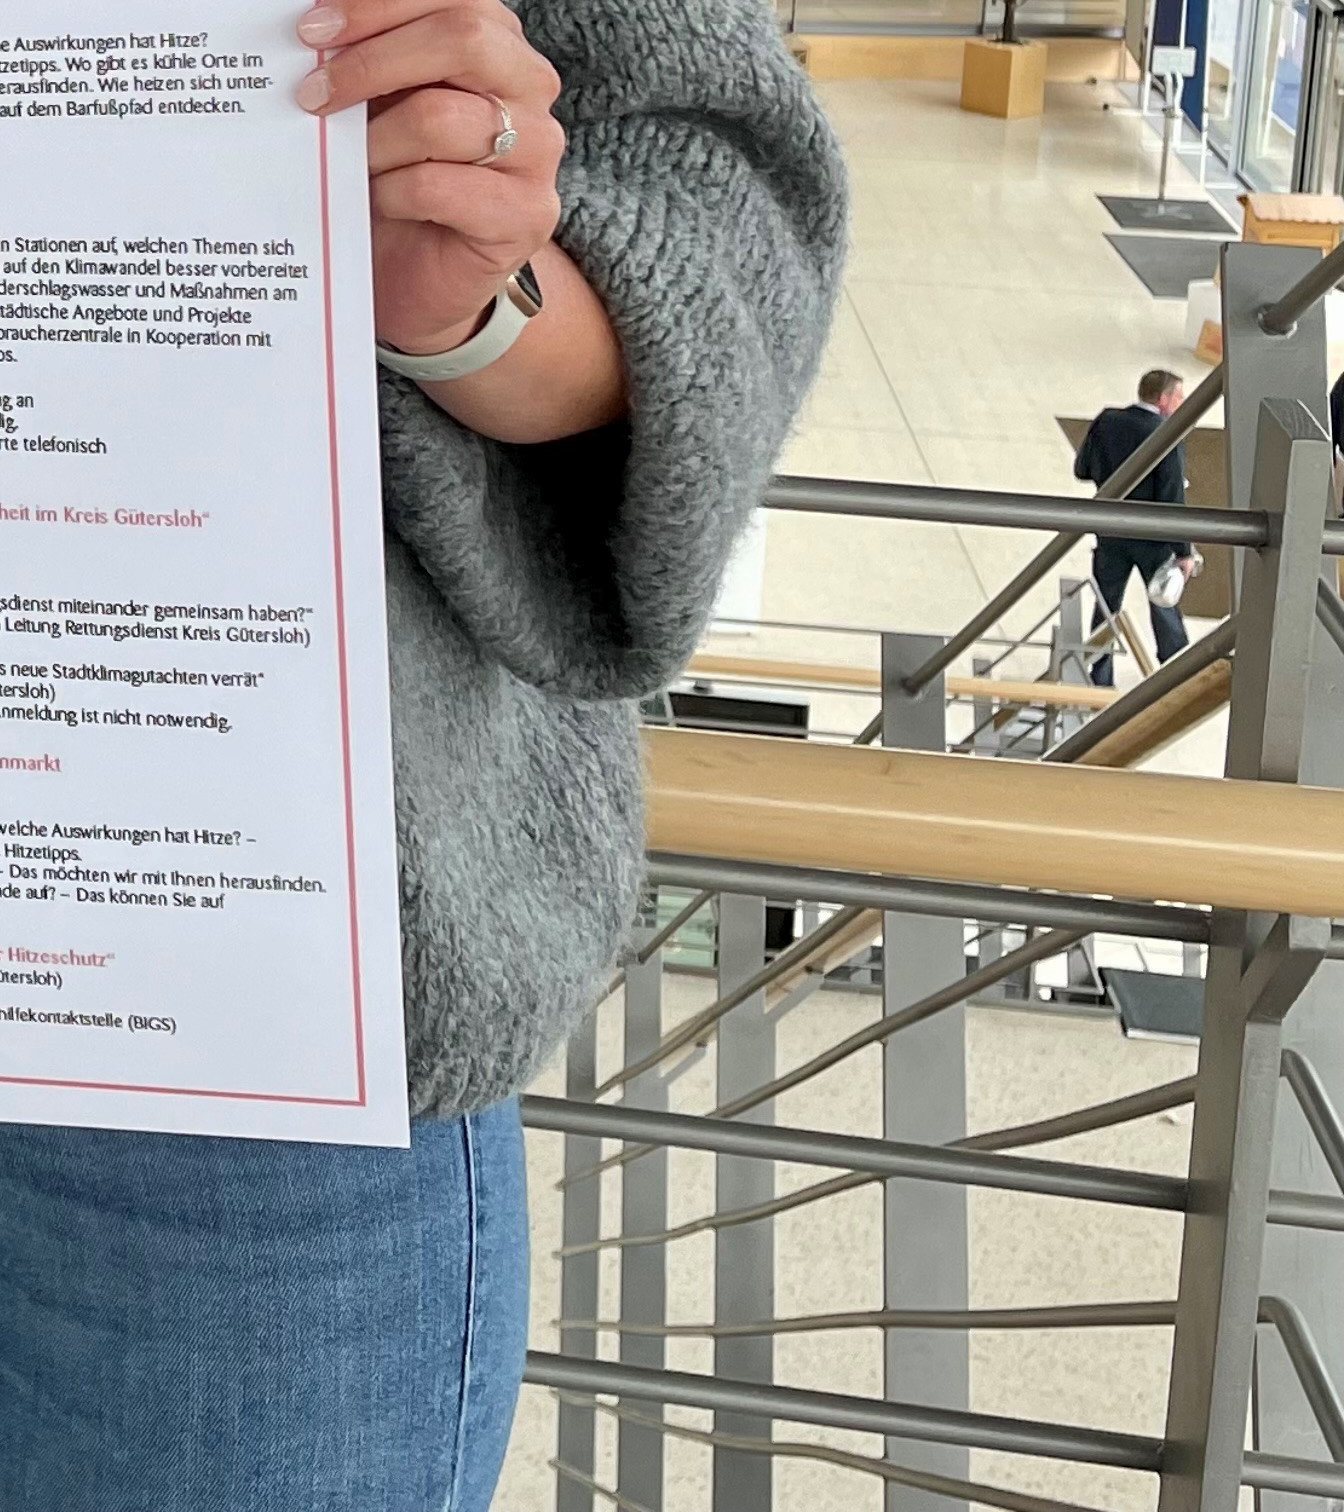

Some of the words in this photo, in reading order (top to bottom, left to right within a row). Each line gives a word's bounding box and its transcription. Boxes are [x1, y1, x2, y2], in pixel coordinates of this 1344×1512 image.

[35, 509, 58, 522] im
[63, 505, 109, 525] Kreis
[128, 1014, 177, 1035] (BIGS)
